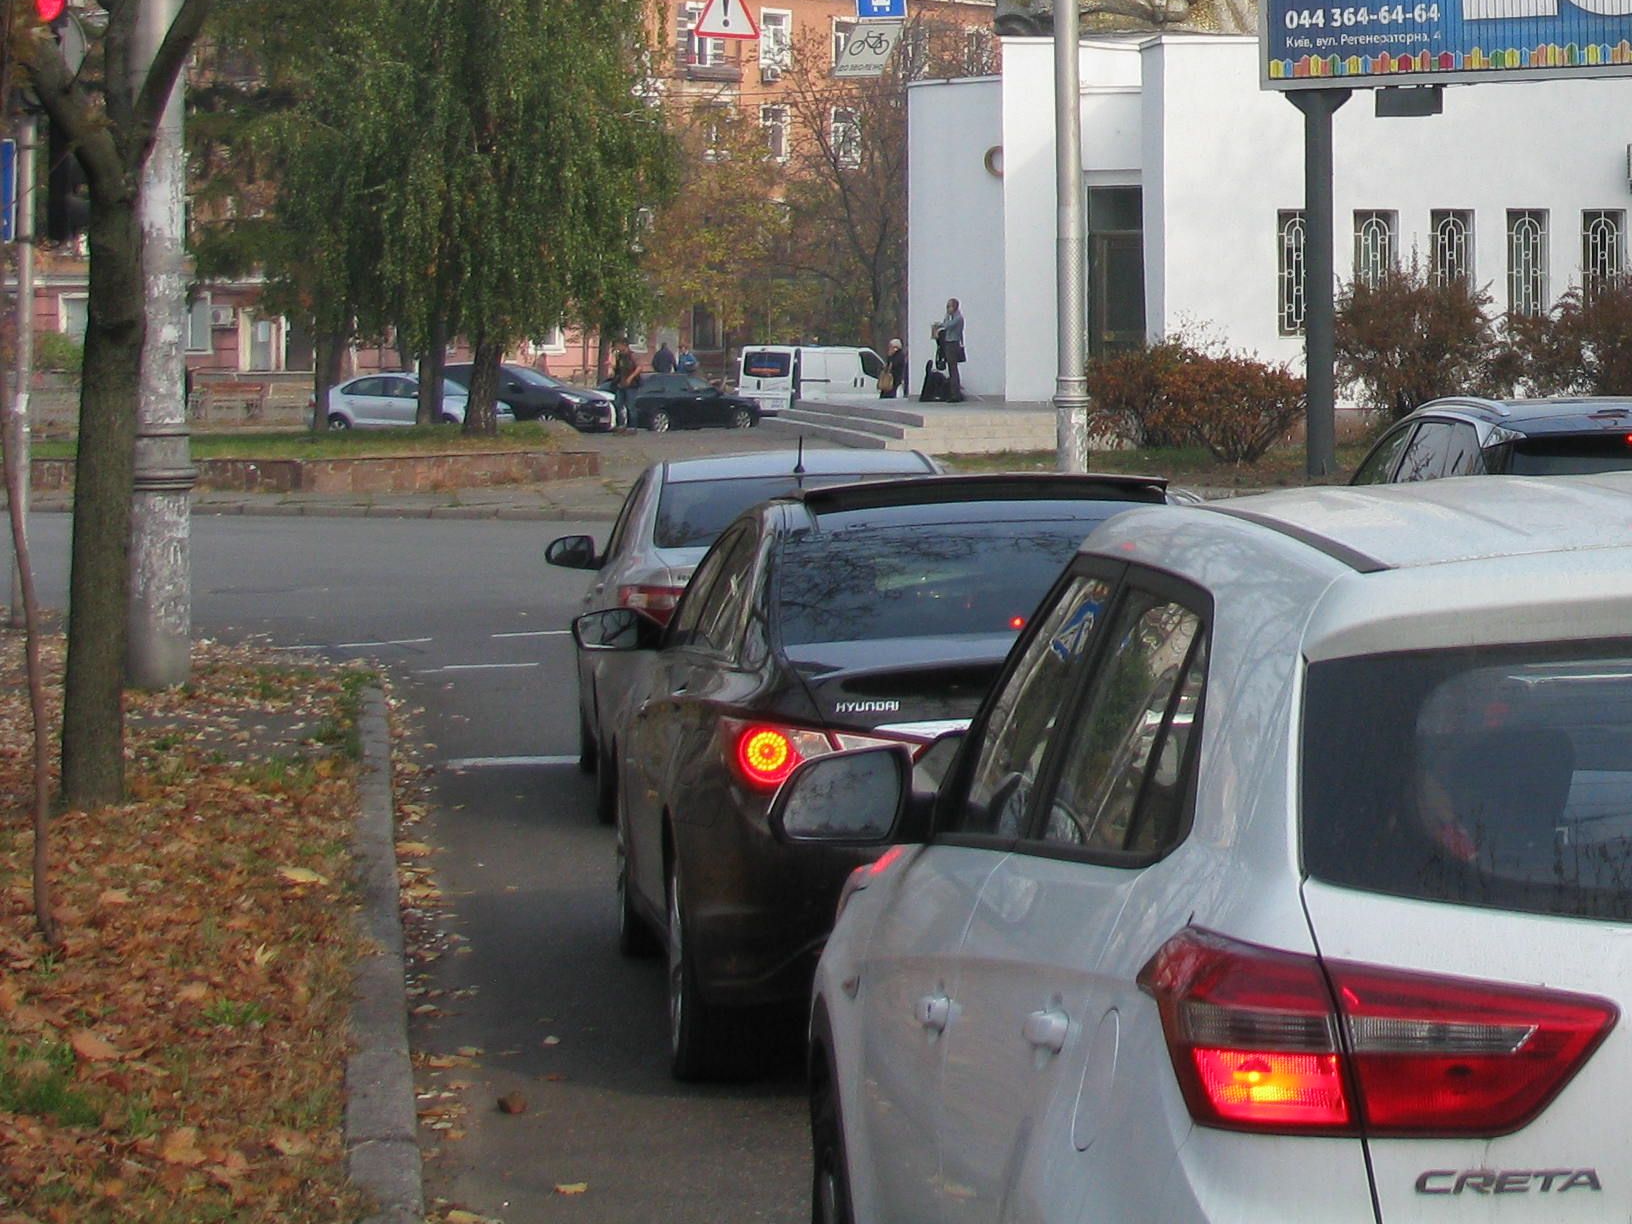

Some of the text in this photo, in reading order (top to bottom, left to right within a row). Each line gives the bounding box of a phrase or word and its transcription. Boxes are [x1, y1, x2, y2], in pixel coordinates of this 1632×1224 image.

[1285, 3, 1441, 29] 044 364-64-64
[1286, 35, 1313, 48] Київ,
[1316, 36, 1338, 50] вул.
[835, 700, 900, 713] HYUNDAI
[1414, 1167, 1602, 1194] CRETA
